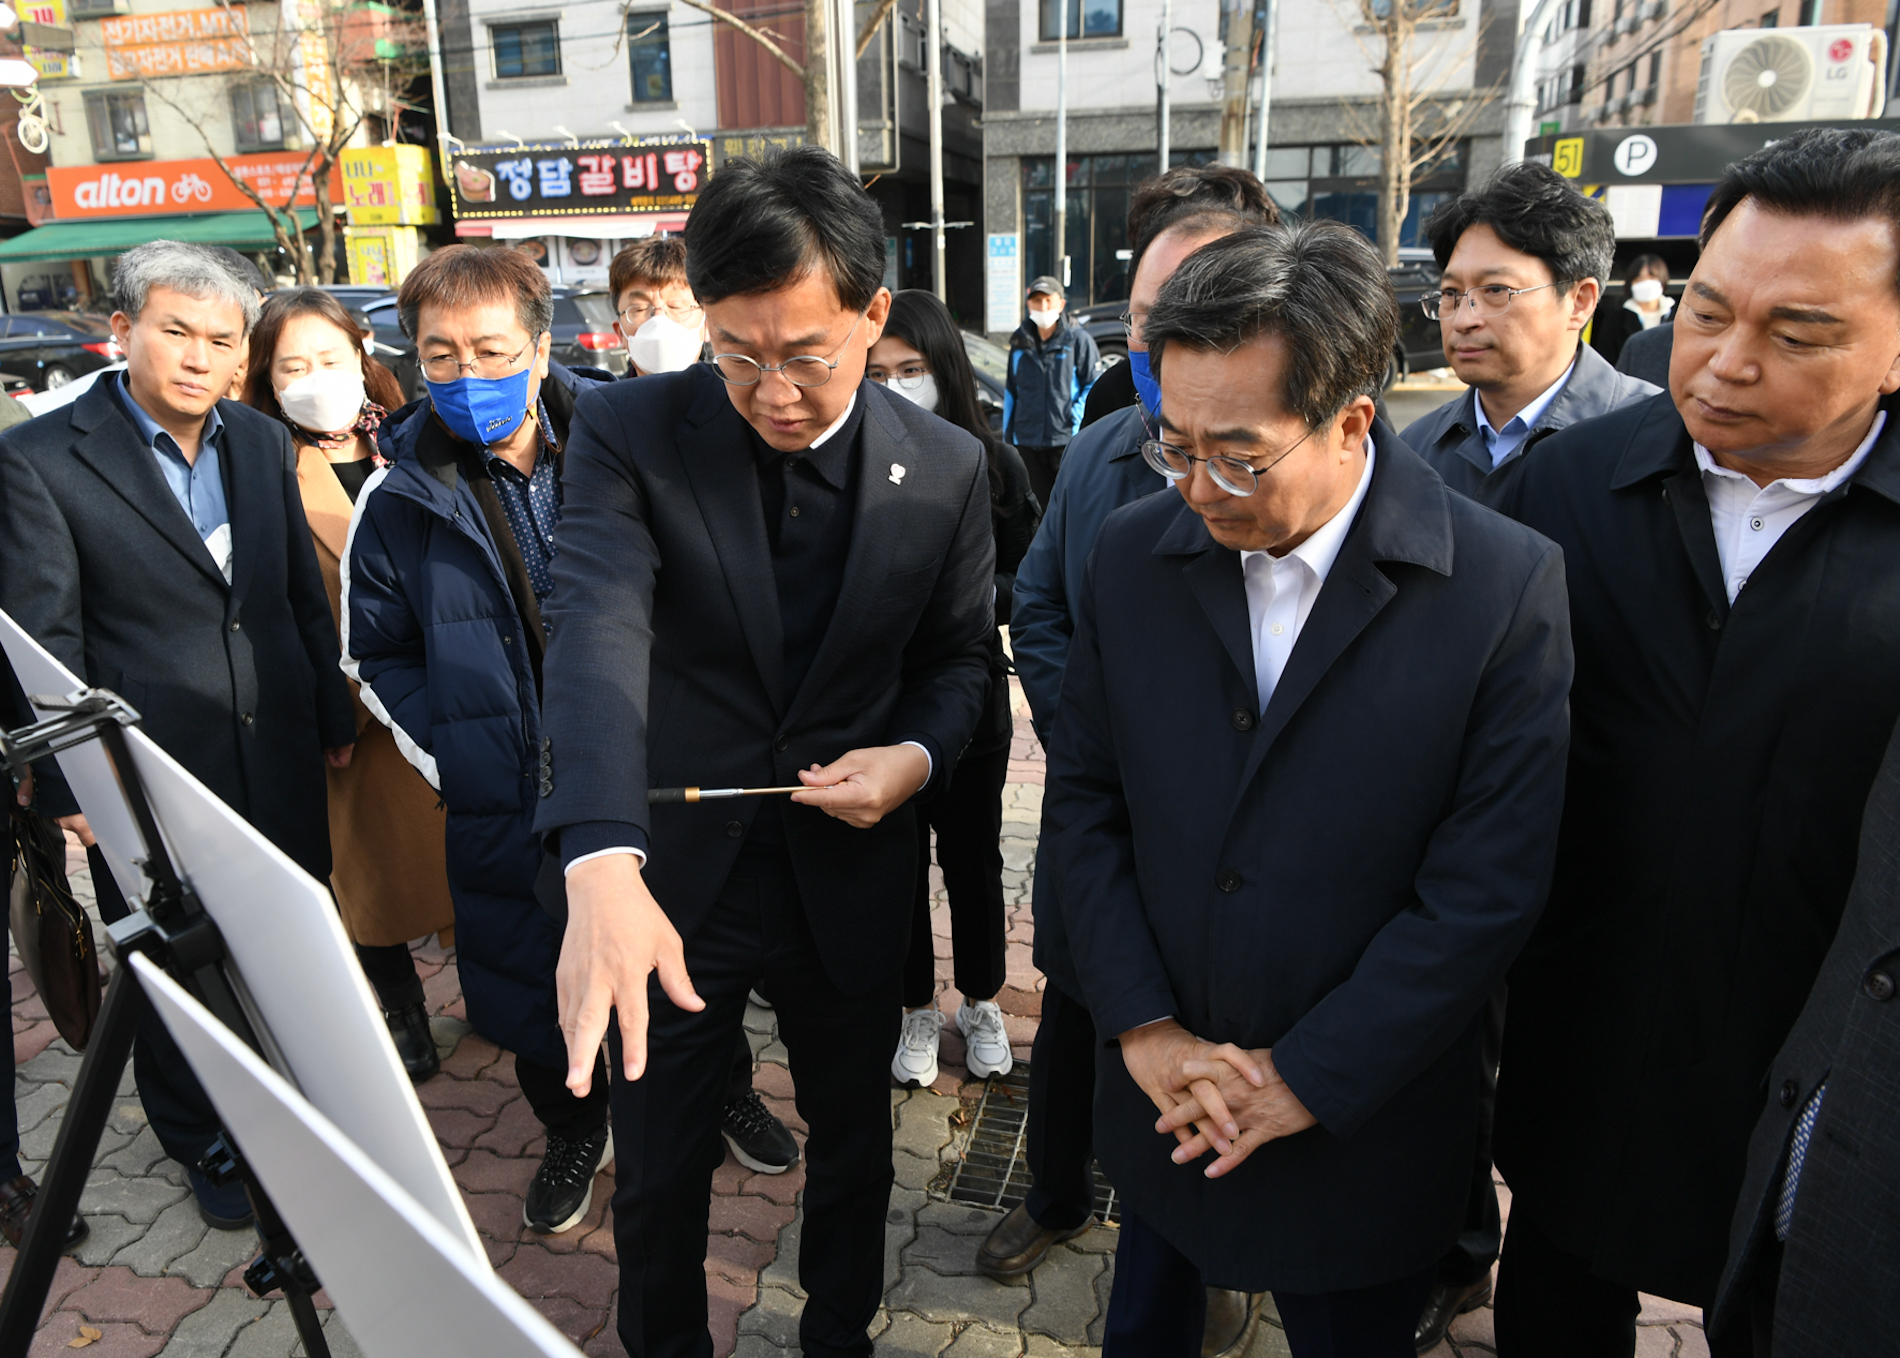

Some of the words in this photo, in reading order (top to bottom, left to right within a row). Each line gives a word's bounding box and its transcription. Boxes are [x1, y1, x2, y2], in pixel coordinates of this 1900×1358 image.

[1826, 67, 1848, 81] LG
[1557, 143, 1579, 173] 51
[1627, 141, 1649, 169] P
[74, 173, 166, 209] alton
